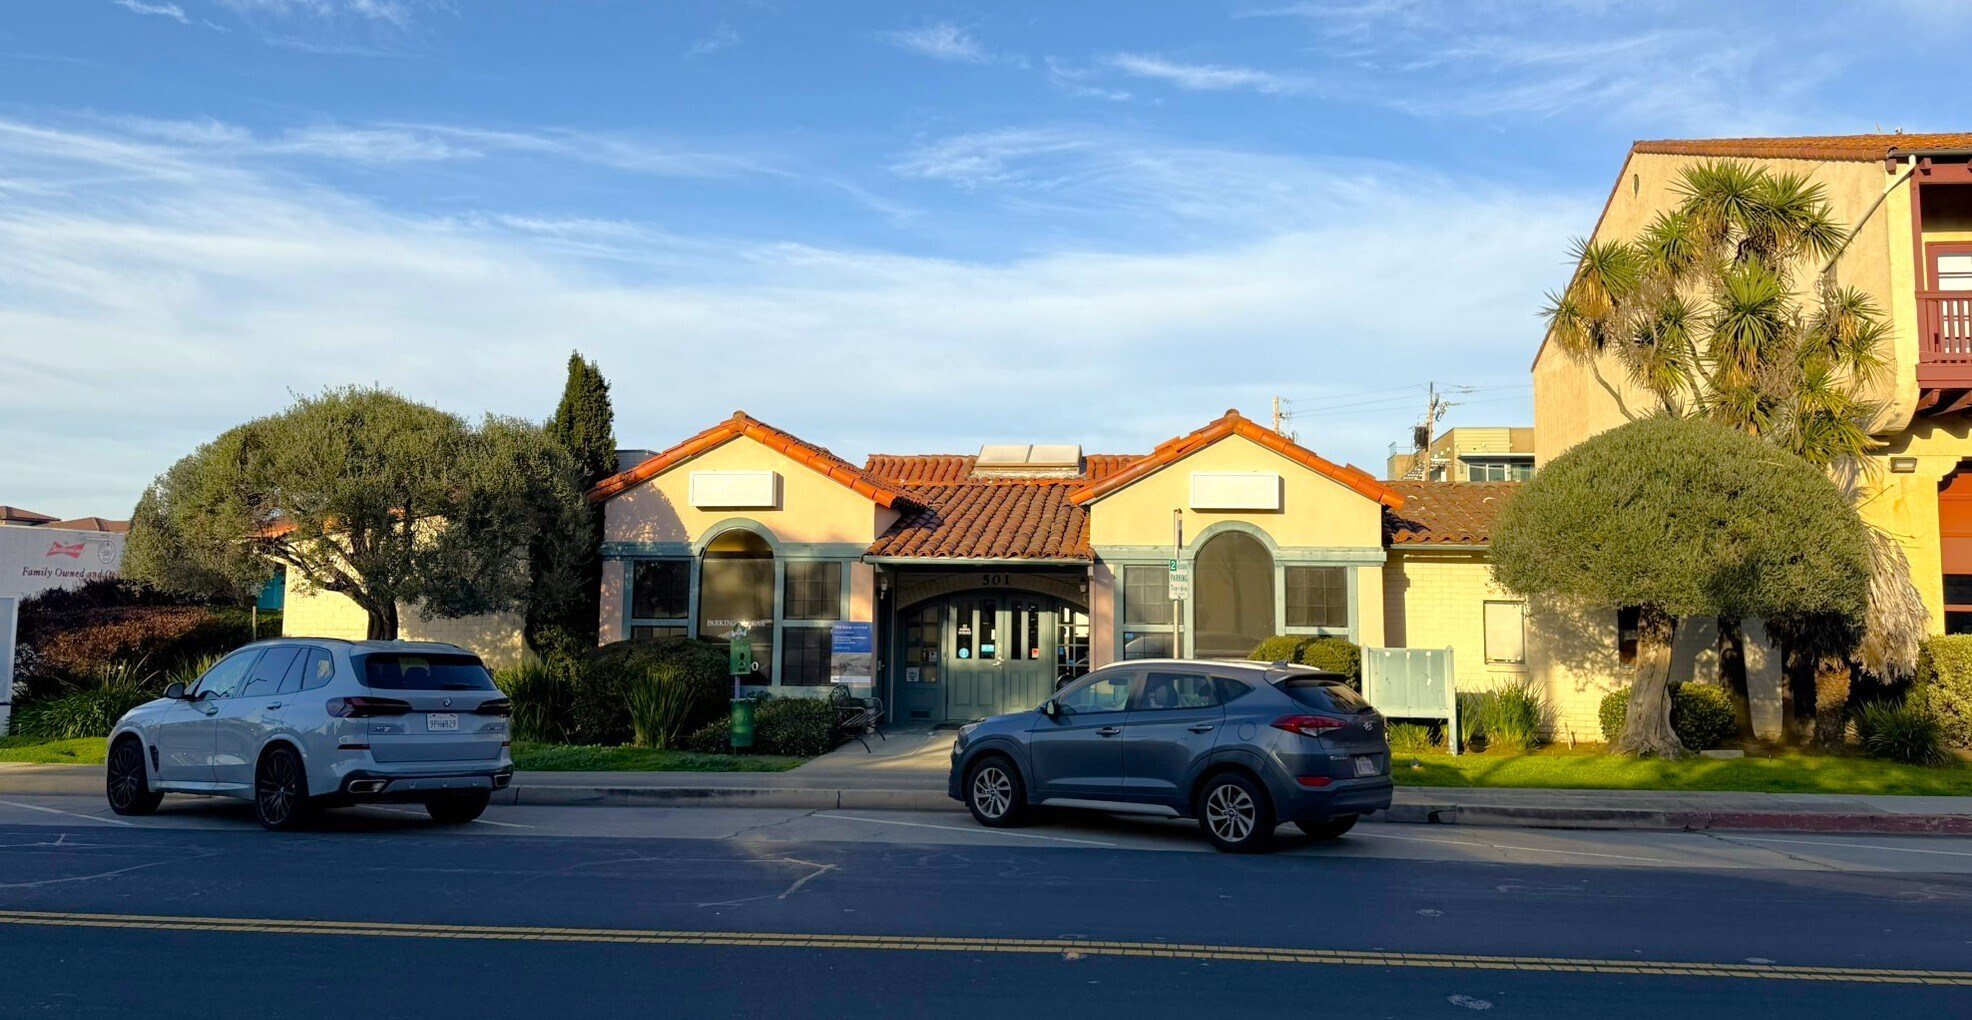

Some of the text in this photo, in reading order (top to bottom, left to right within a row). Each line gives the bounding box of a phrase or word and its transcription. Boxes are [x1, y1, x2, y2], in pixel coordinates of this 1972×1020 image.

[1170, 560, 1176, 570] 2
[22, 566, 53, 579] Family
[55, 567, 85, 578] Owned
[1170, 573, 1188, 582] PARKING
[982, 574, 1010, 586] 501
[706, 619, 736, 627] PARKING
